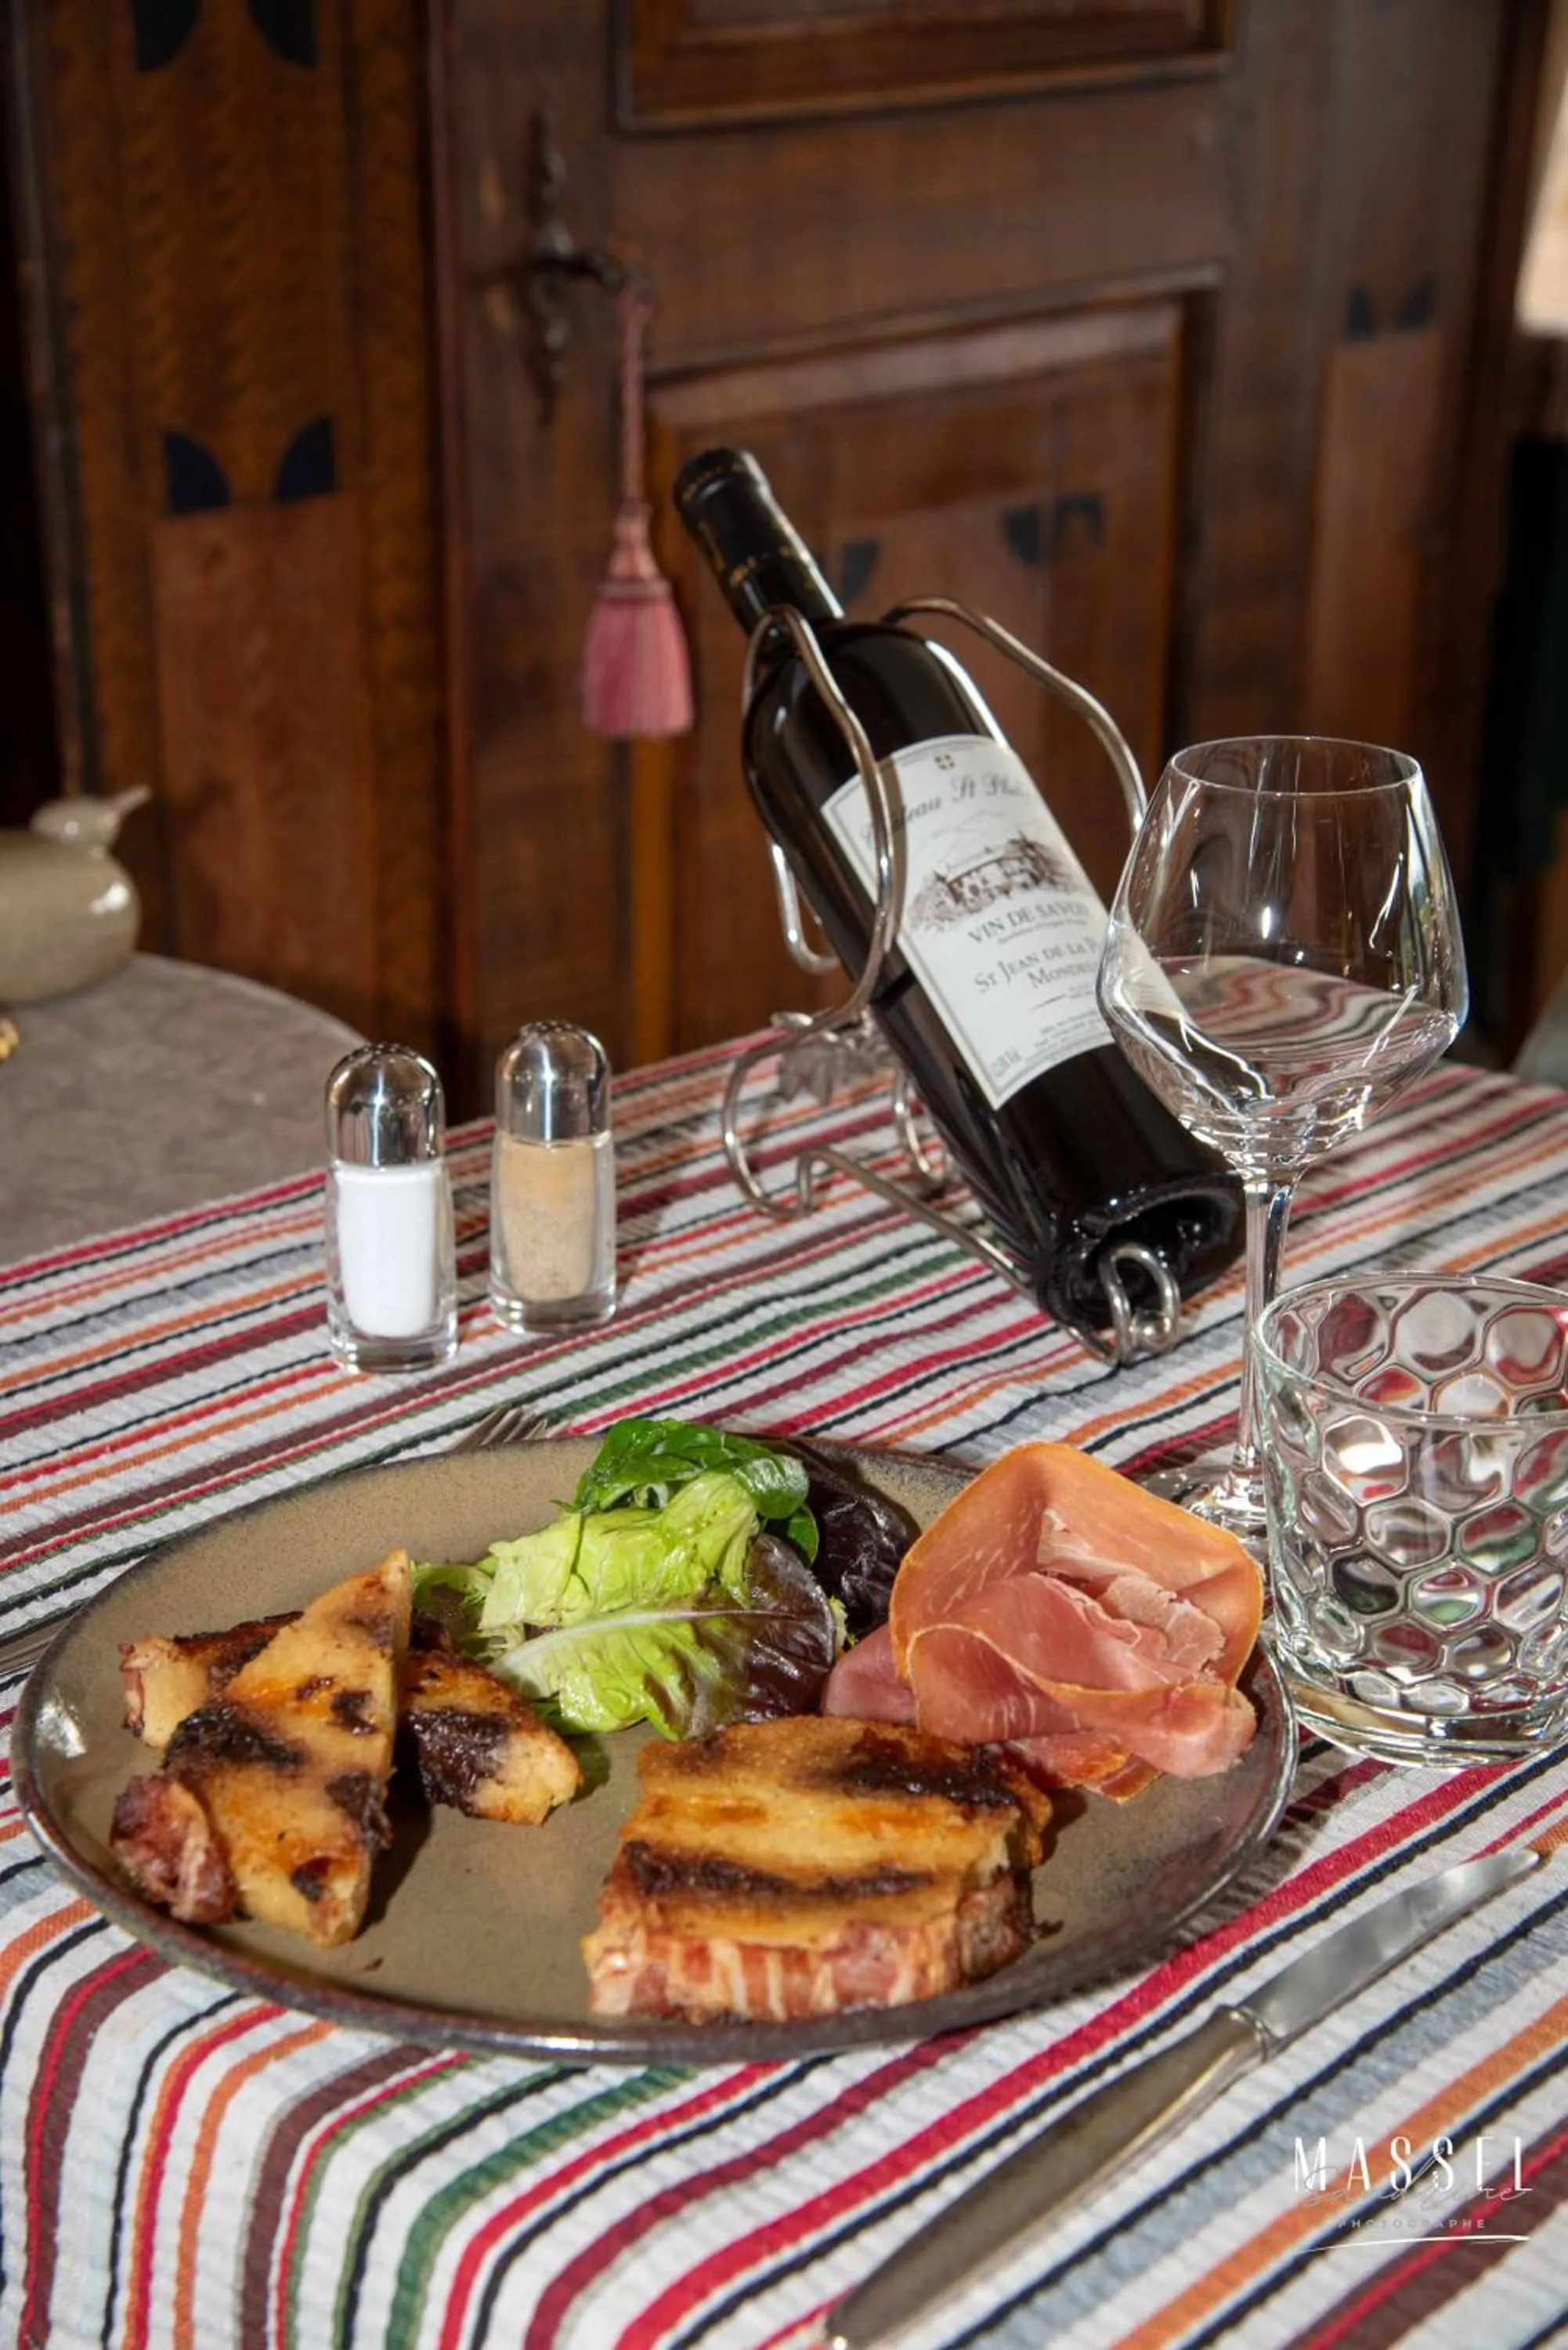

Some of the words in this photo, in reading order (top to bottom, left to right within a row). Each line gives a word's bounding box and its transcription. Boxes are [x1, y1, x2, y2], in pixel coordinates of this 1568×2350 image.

[968, 917, 1006, 943] VIN
[1007, 907, 1035, 927] DE
[1035, 901, 1090, 918] SAVOI
